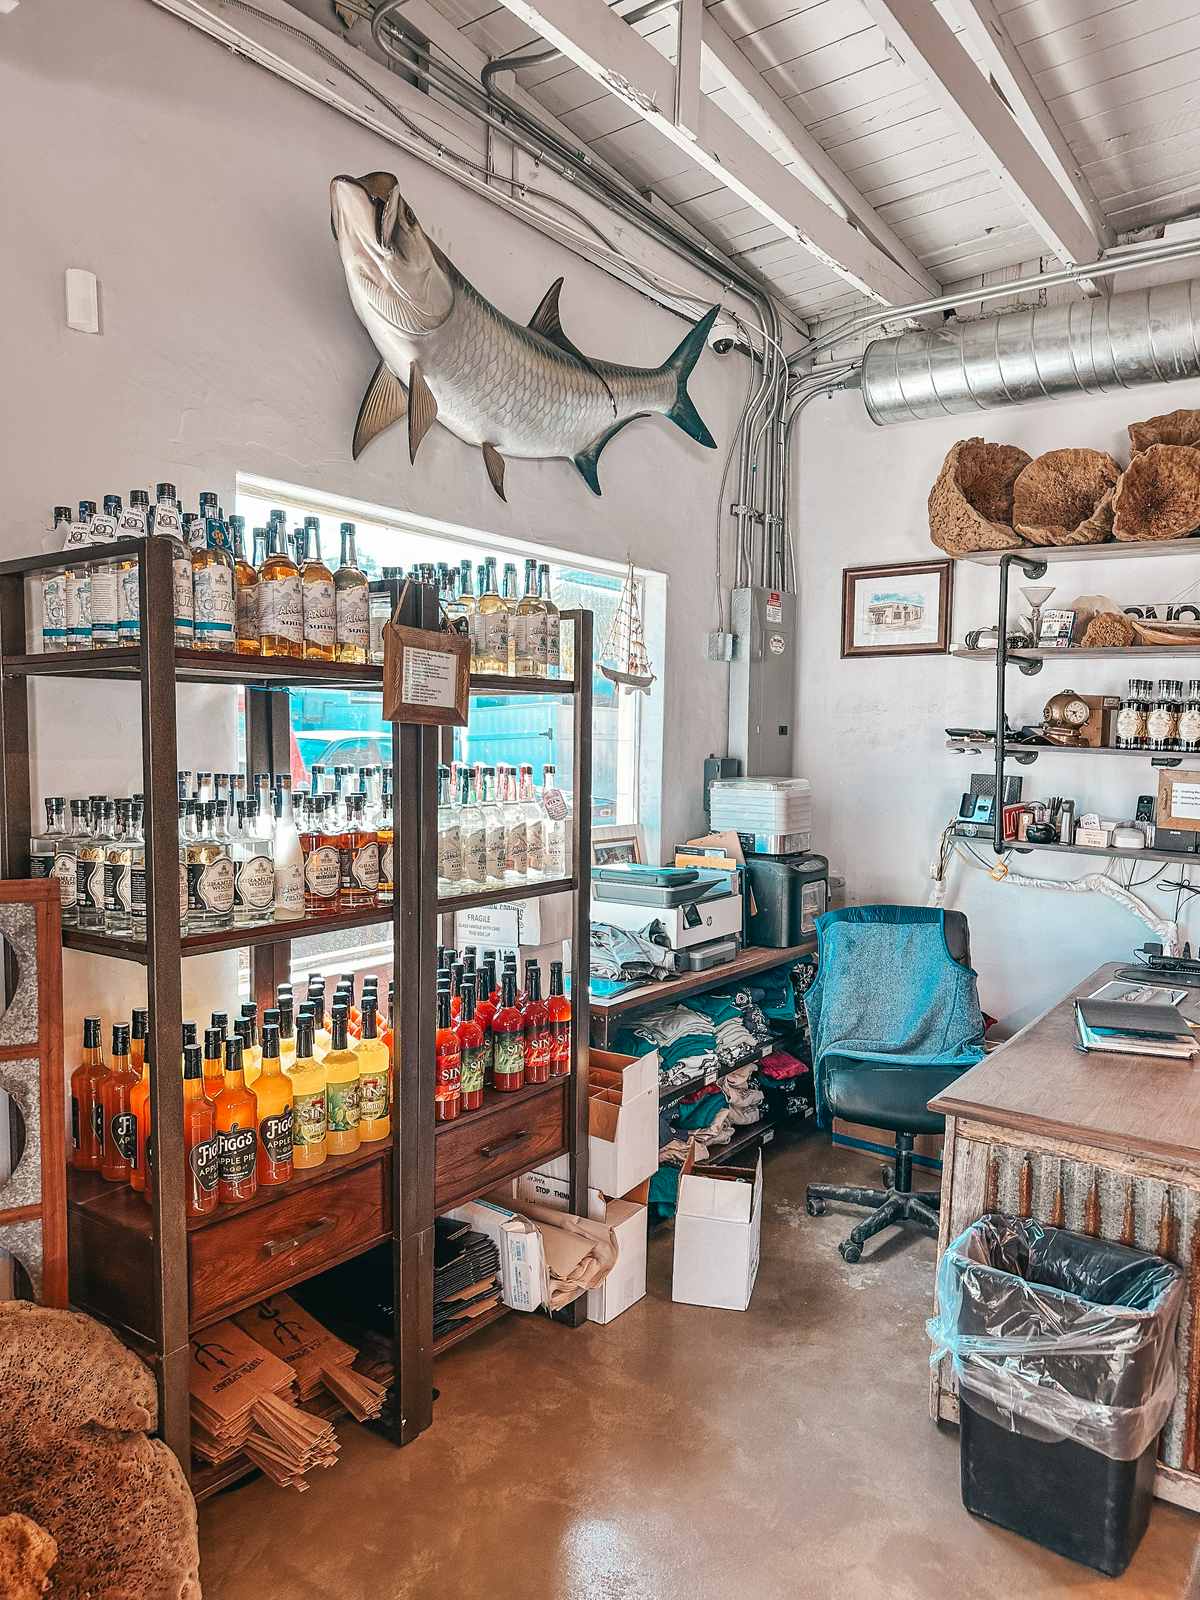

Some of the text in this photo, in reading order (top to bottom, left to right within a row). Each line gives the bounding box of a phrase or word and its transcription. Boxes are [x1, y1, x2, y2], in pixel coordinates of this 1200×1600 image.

[466, 913, 491, 924] FRAGILE
[535, 1185, 571, 1200] STOP THIN
